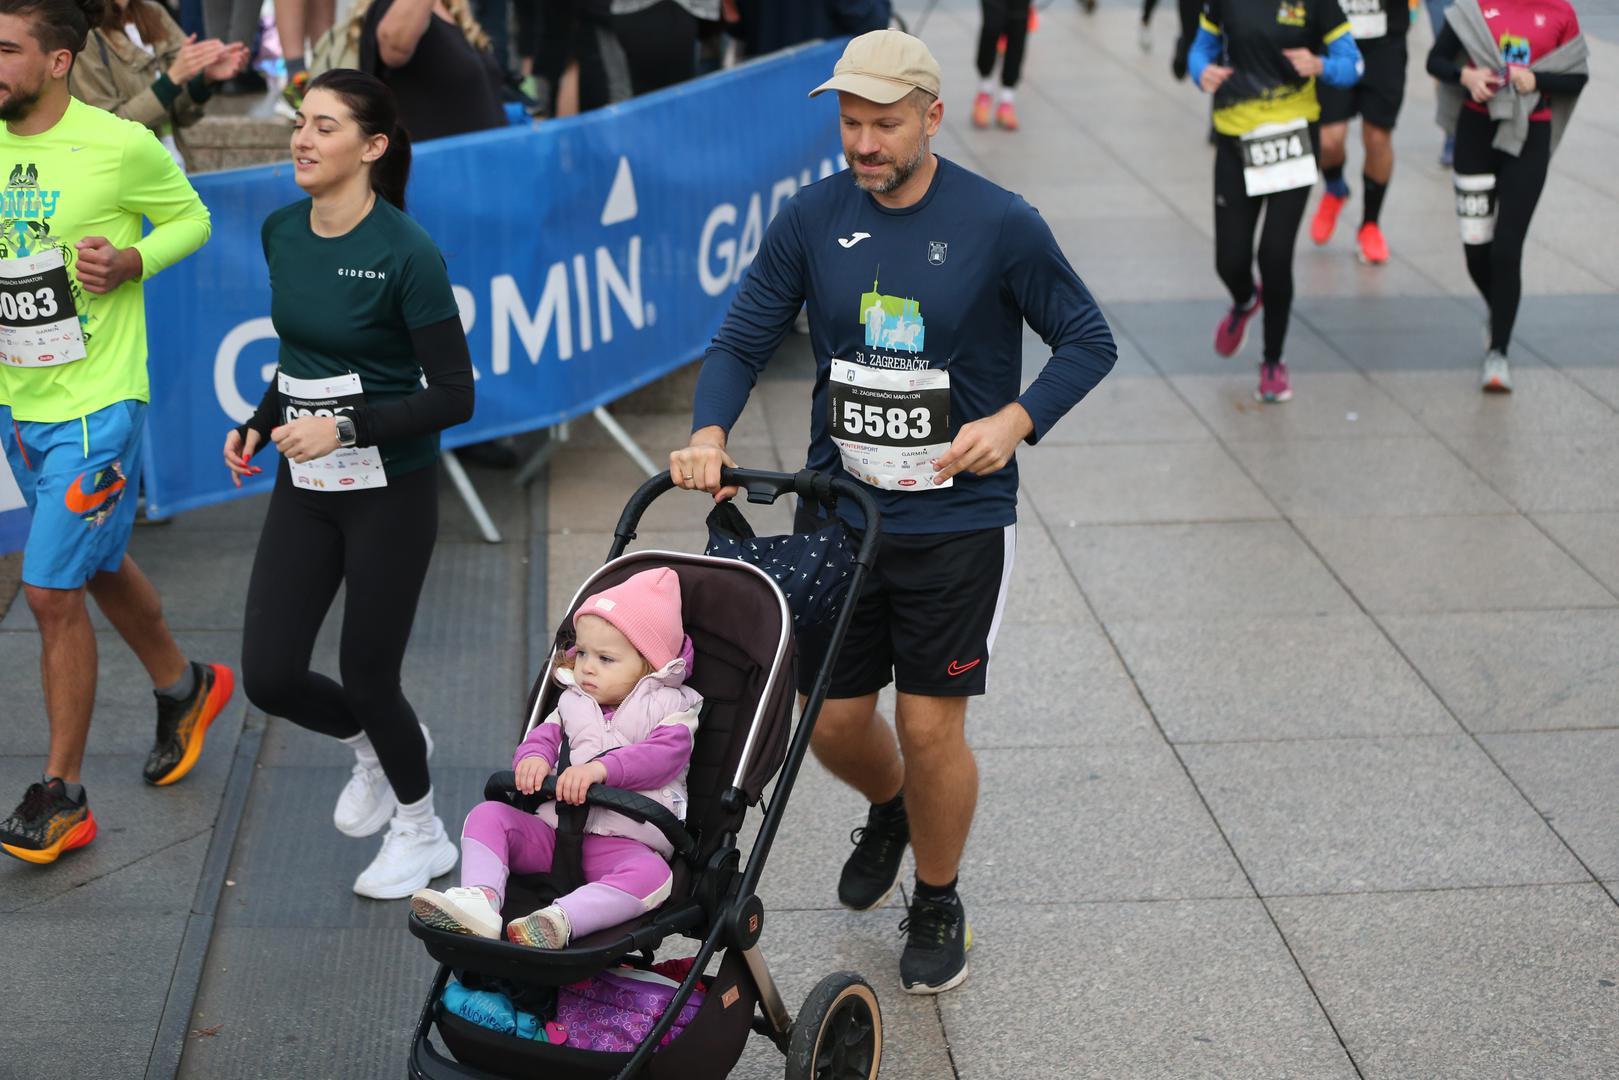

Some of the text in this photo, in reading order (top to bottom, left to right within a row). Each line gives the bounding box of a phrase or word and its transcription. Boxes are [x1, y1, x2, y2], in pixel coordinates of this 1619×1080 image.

[1250, 135, 1304, 166] 5374
[0, 191, 60, 218] NLY
[337, 267, 385, 280] GIDEON
[0, 287, 58, 321] 083
[869, 354, 930, 371] ZAGREBAČKI
[859, 389, 893, 400] ZAGREBAČKI
[893, 393, 921, 401] MARATON
[843, 400, 932, 440] 5583
[844, 443, 878, 454] INTERSPORT
